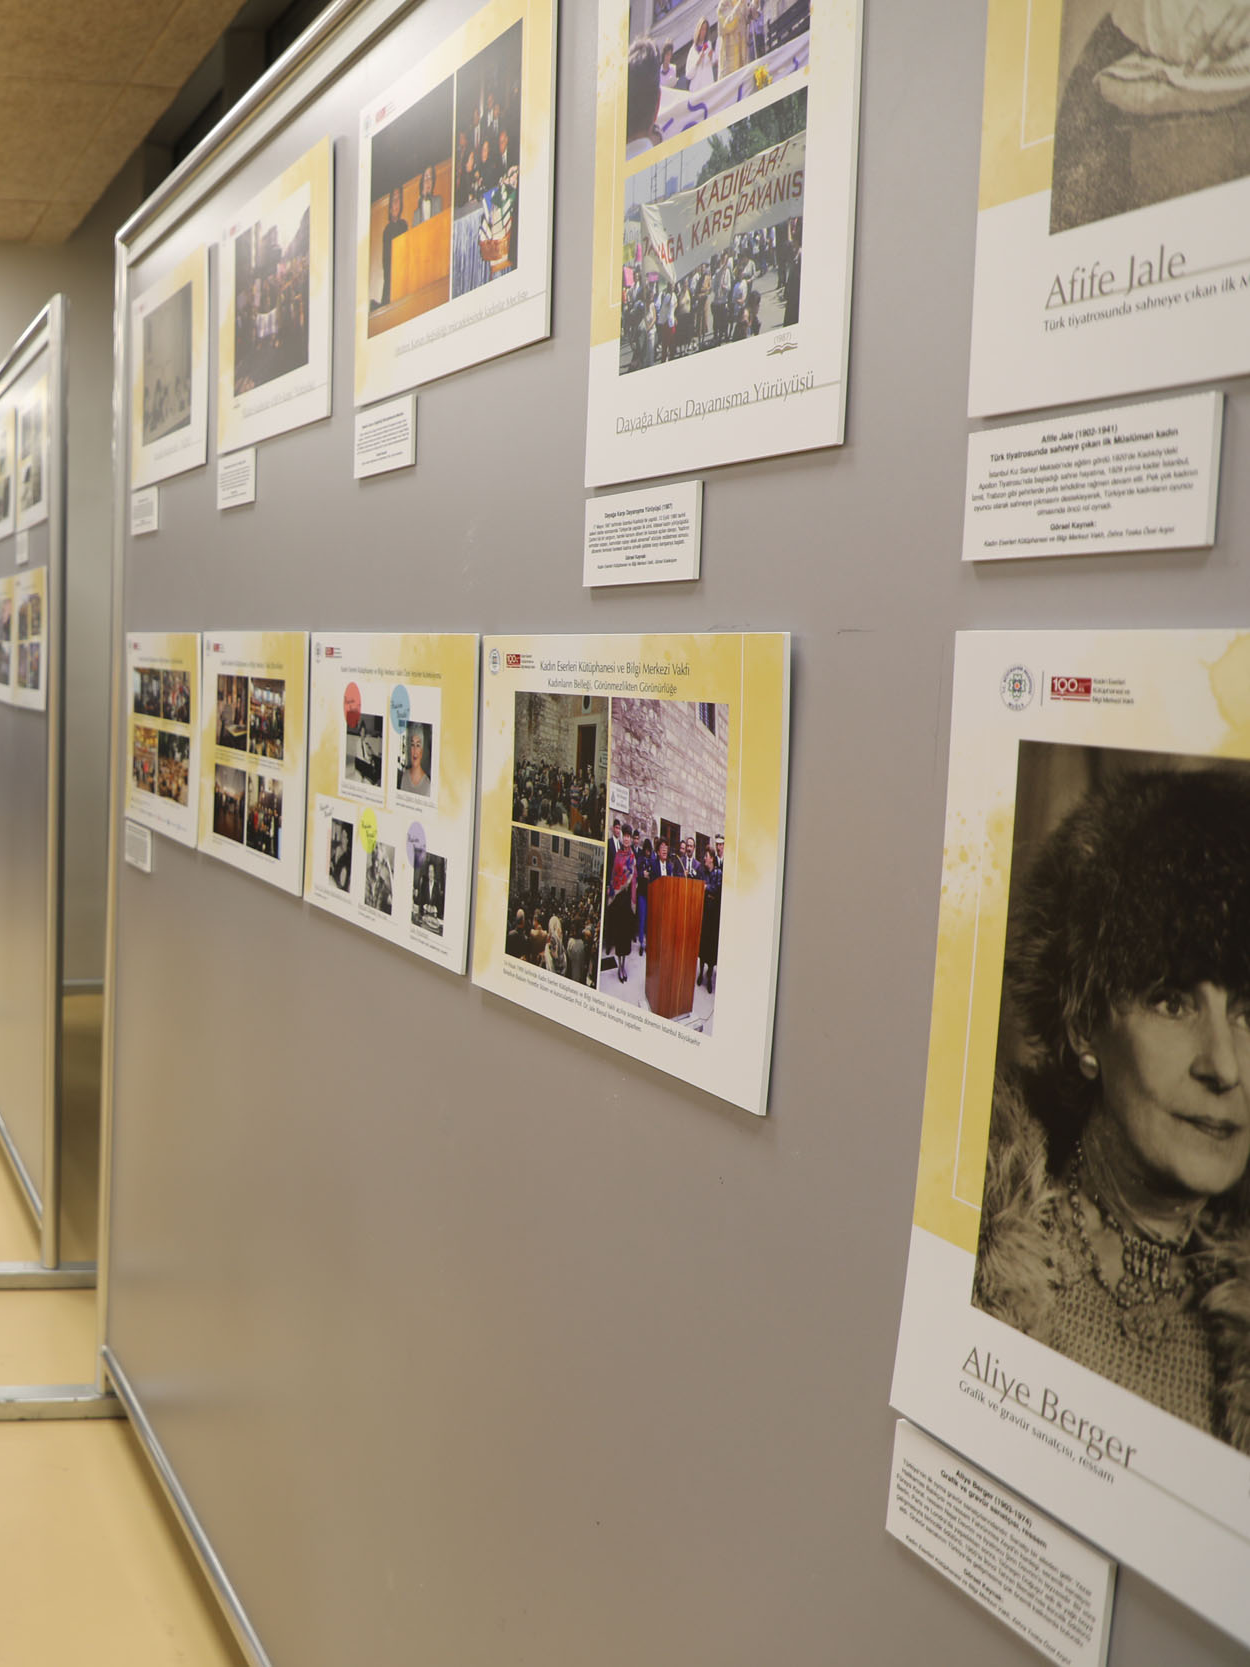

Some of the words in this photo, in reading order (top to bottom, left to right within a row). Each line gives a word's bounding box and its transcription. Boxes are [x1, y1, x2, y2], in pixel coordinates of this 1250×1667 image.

[1043, 319, 1065, 333] Türk
[1068, 302, 1132, 328] tiyatrosunda
[1135, 292, 1181, 312] sahneye
[1184, 284, 1217, 302] çıkan
[1221, 275, 1236, 292] ilk
[1045, 261, 1115, 310] Afife
[1125, 244, 1185, 295] Jale
[616, 413, 653, 436] Dayağa
[656, 406, 682, 425] Karşı
[685, 391, 749, 420] Dayanışma
[753, 370, 815, 406] Yürüyüşü
[989, 452, 1005, 463] Türk
[1005, 446, 1048, 461] tiyatrosunda
[1049, 441, 1079, 455] sahneye
[1113, 430, 1154, 445] Müslüman
[540, 661, 556, 672] Kadın
[557, 661, 577, 672] Eserleri
[578, 661, 615, 676] Kütüphanesi
[617, 663, 625, 673] ve
[626, 662, 641, 677] Bilgi
[642, 663, 670, 675] Merkezi
[672, 663, 690, 676] Vakfı
[959, 1380, 985, 1404] Grafik
[988, 1400, 999, 1412] ve
[1000, 1408, 1030, 1432] gravür
[1032, 1426, 1076, 1462] sanatçısı,
[1078, 1455, 1115, 1485] ressam
[962, 1347, 1030, 1403] Aliye
[1041, 1388, 1137, 1468] Berger
